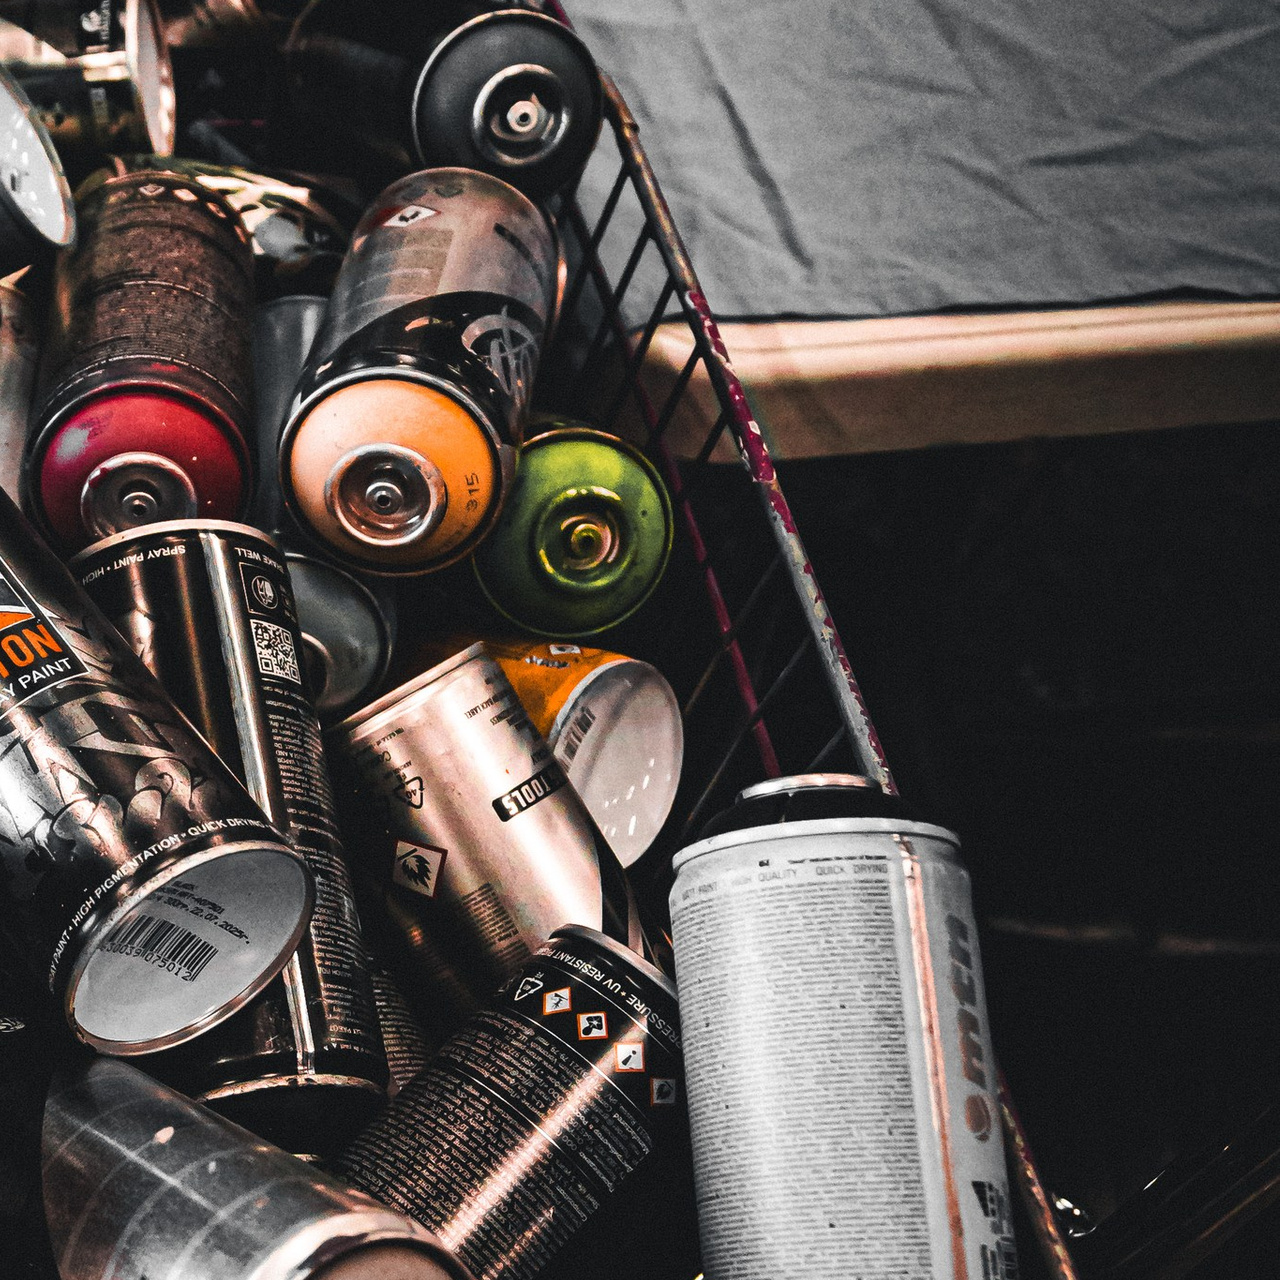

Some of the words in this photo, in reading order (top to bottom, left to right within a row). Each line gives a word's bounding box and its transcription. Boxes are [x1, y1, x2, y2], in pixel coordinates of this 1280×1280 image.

[464, 472, 481, 512] 315
[111, 551, 144, 569] PAINT
[145, 543, 186, 559] SPRAY
[232, 546, 263, 561] WELL
[18, 656, 74, 690] PAINT
[757, 868, 798, 882] QUALITY
[815, 864, 846, 876] QUICK
[853, 863, 887, 874] DRYING
[50, 929, 71, 964] PAINT
[70, 895, 96, 926] HIGH
[92, 832, 182, 899] PIGMENTATION
[187, 818, 227, 836] QUICK
[143, 950, 193, 981] 075012
[553, 948, 605, 982] RESISTANT
[601, 975, 622, 994] UV
